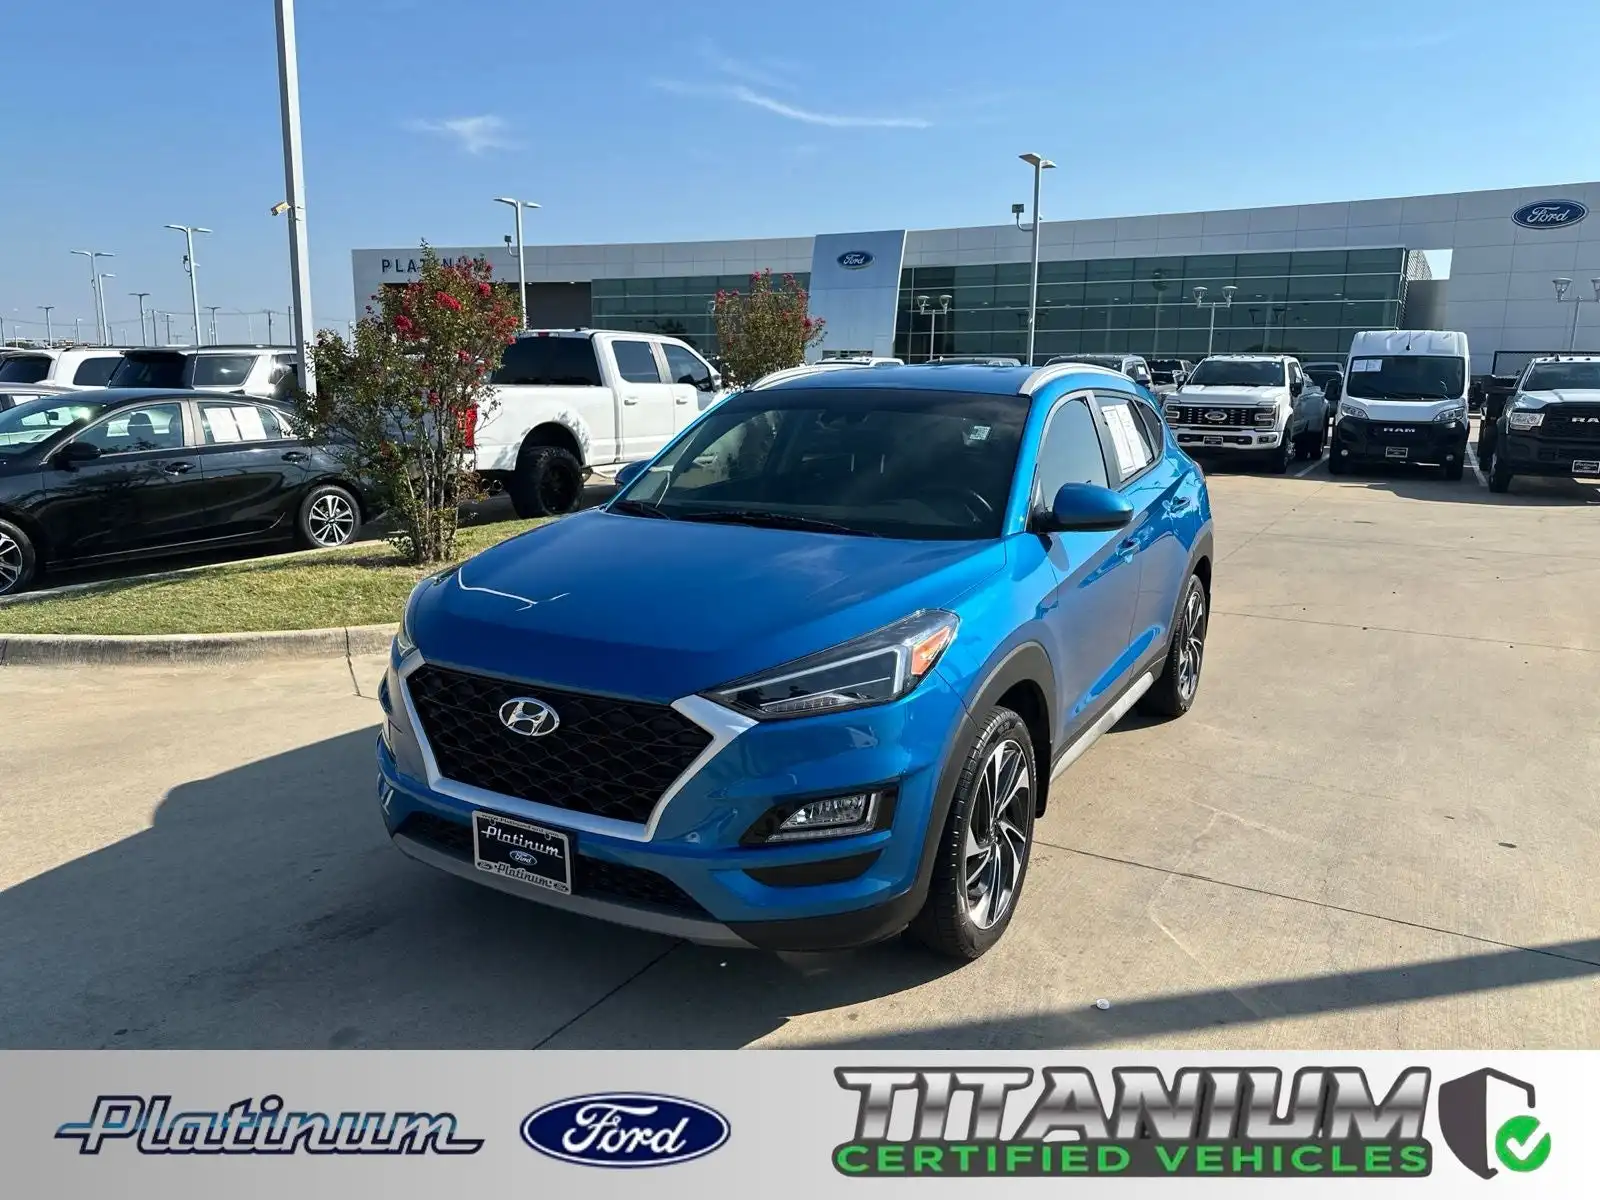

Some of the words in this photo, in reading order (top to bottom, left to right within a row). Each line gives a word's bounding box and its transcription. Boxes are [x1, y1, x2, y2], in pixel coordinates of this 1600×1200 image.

[1526, 206, 1570, 222] Ford
[381, 258, 486, 273] PLATNM
[843, 254, 865, 265] Ford
[481, 826, 563, 859] Platinum
[513, 851, 533, 864] Ford
[496, 862, 553, 888] Platinum
